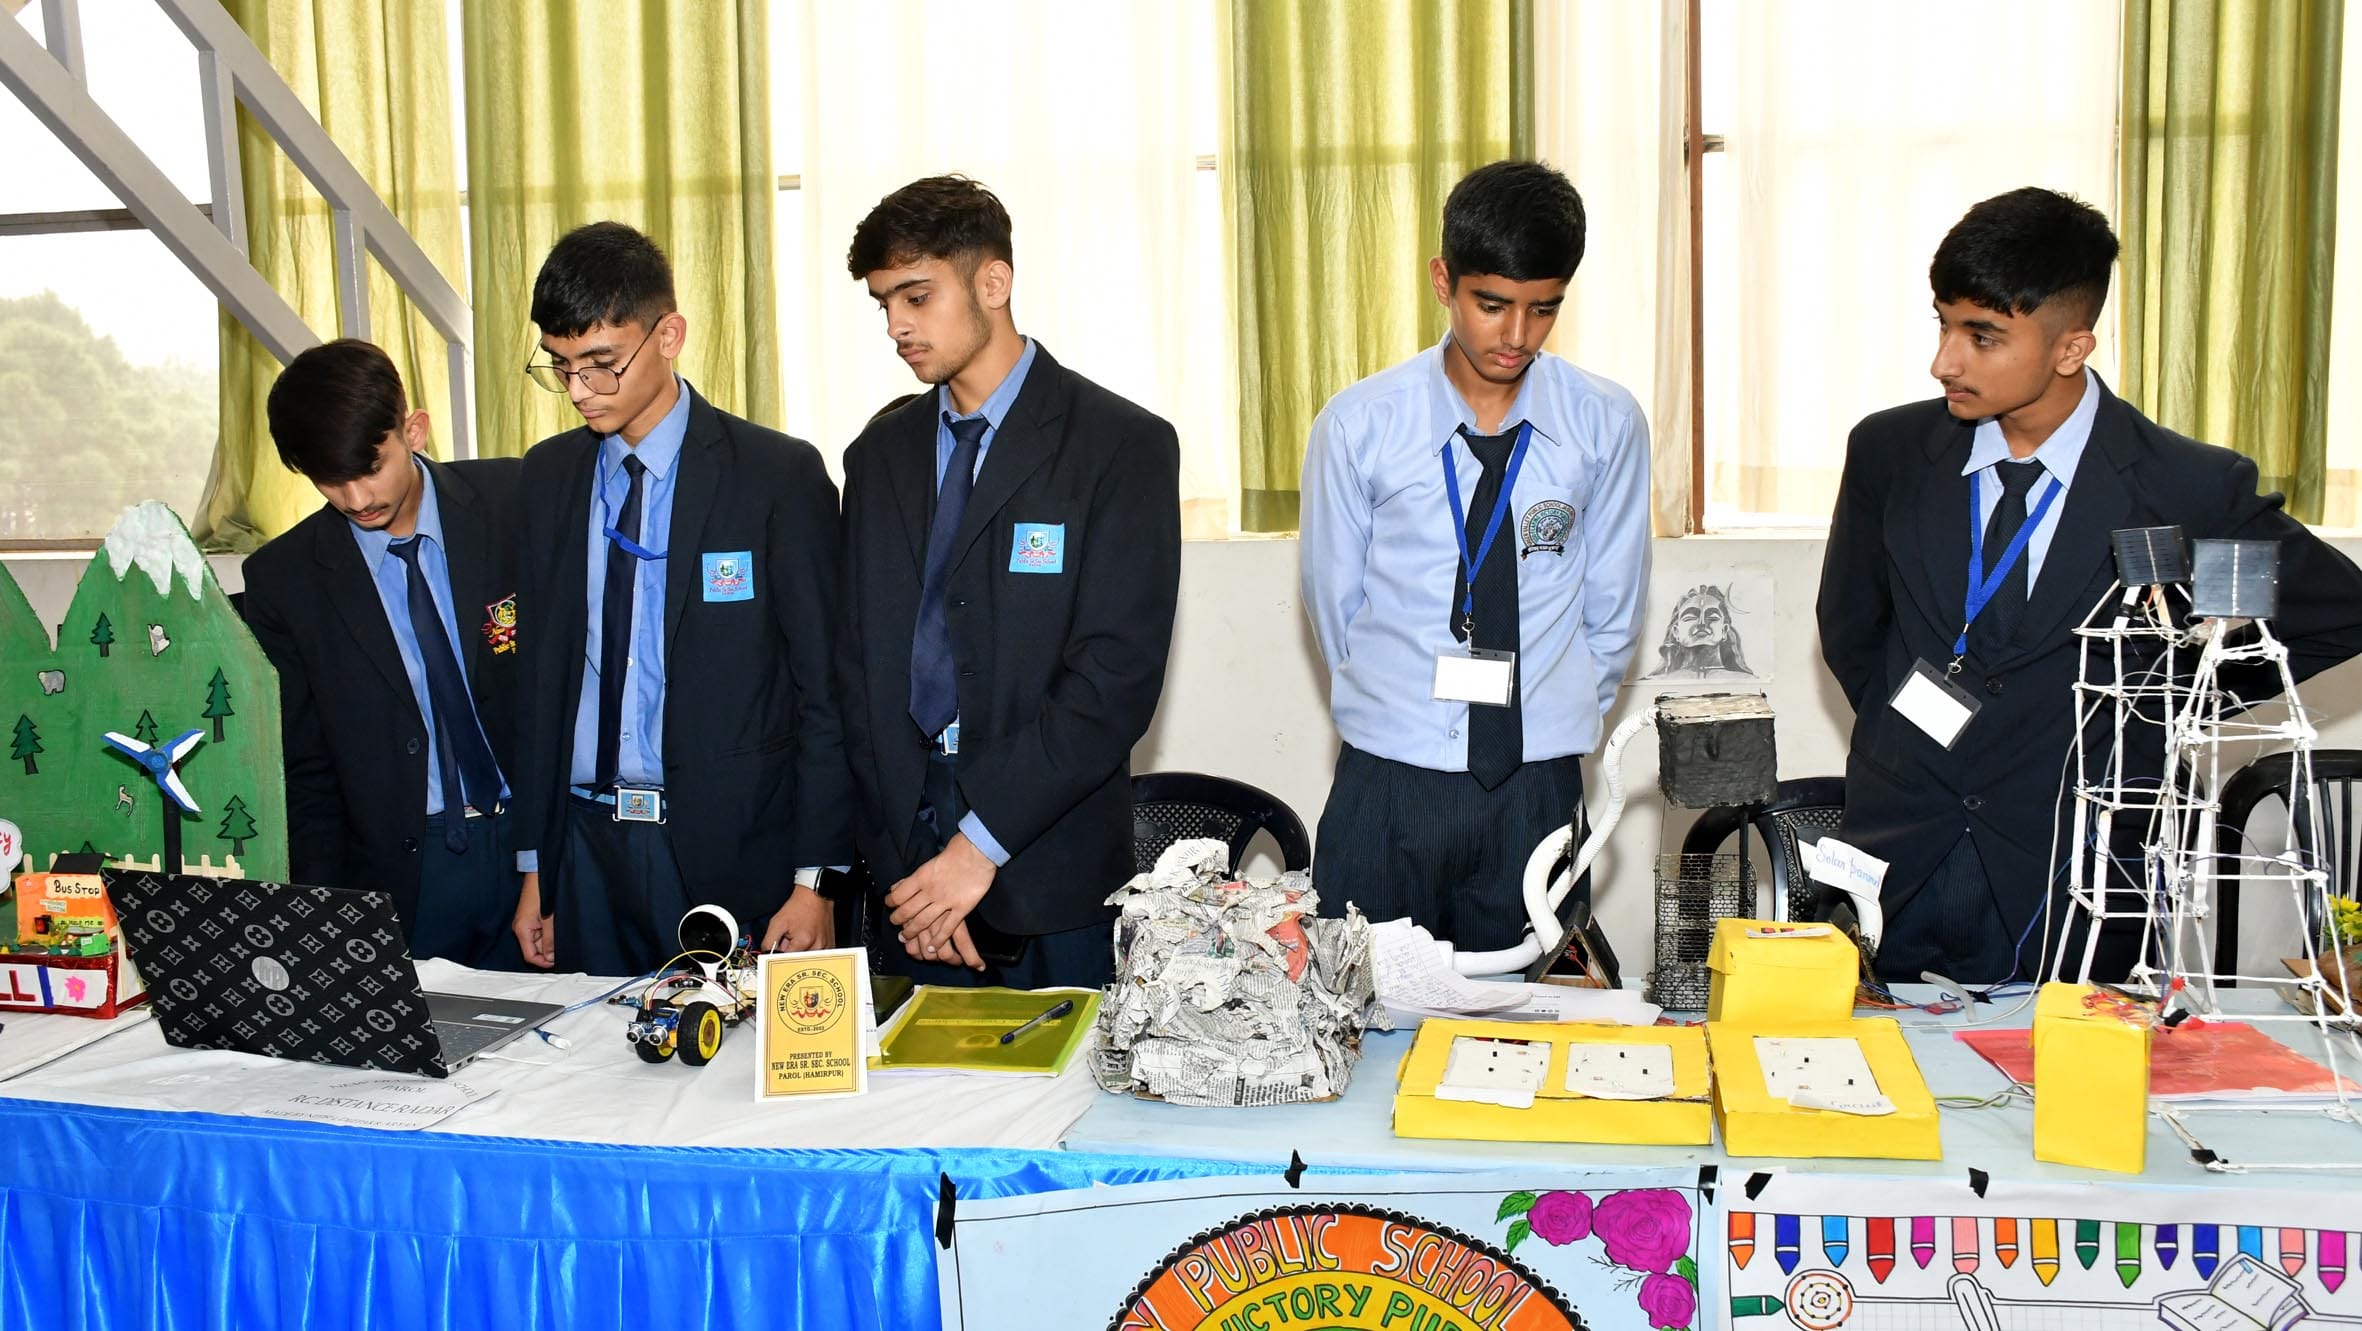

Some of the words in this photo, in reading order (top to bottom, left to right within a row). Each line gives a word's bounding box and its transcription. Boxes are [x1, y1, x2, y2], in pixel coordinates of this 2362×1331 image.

[783, 979, 796, 993] ERA
[812, 970, 828, 979] SEC.
[830, 978, 844, 1008] SCHOOL
[771, 1062, 785, 1070] NEW
[786, 1061, 798, 1069] ERA
[800, 1060, 809, 1069] SR.
[811, 1059, 824, 1068] SEC.
[826, 1058, 850, 1067] SCHOOL
[789, 1051, 823, 1060] PRESENTED
[779, 1072, 801, 1080] PAROL
[803, 1070, 844, 1080] (HAMIRPUR)
[1173, 1214, 1340, 1313] PUBLIC
[1373, 1223, 1533, 1331] SCHOOL
[1221, 1284, 1372, 1331] ICTORY
